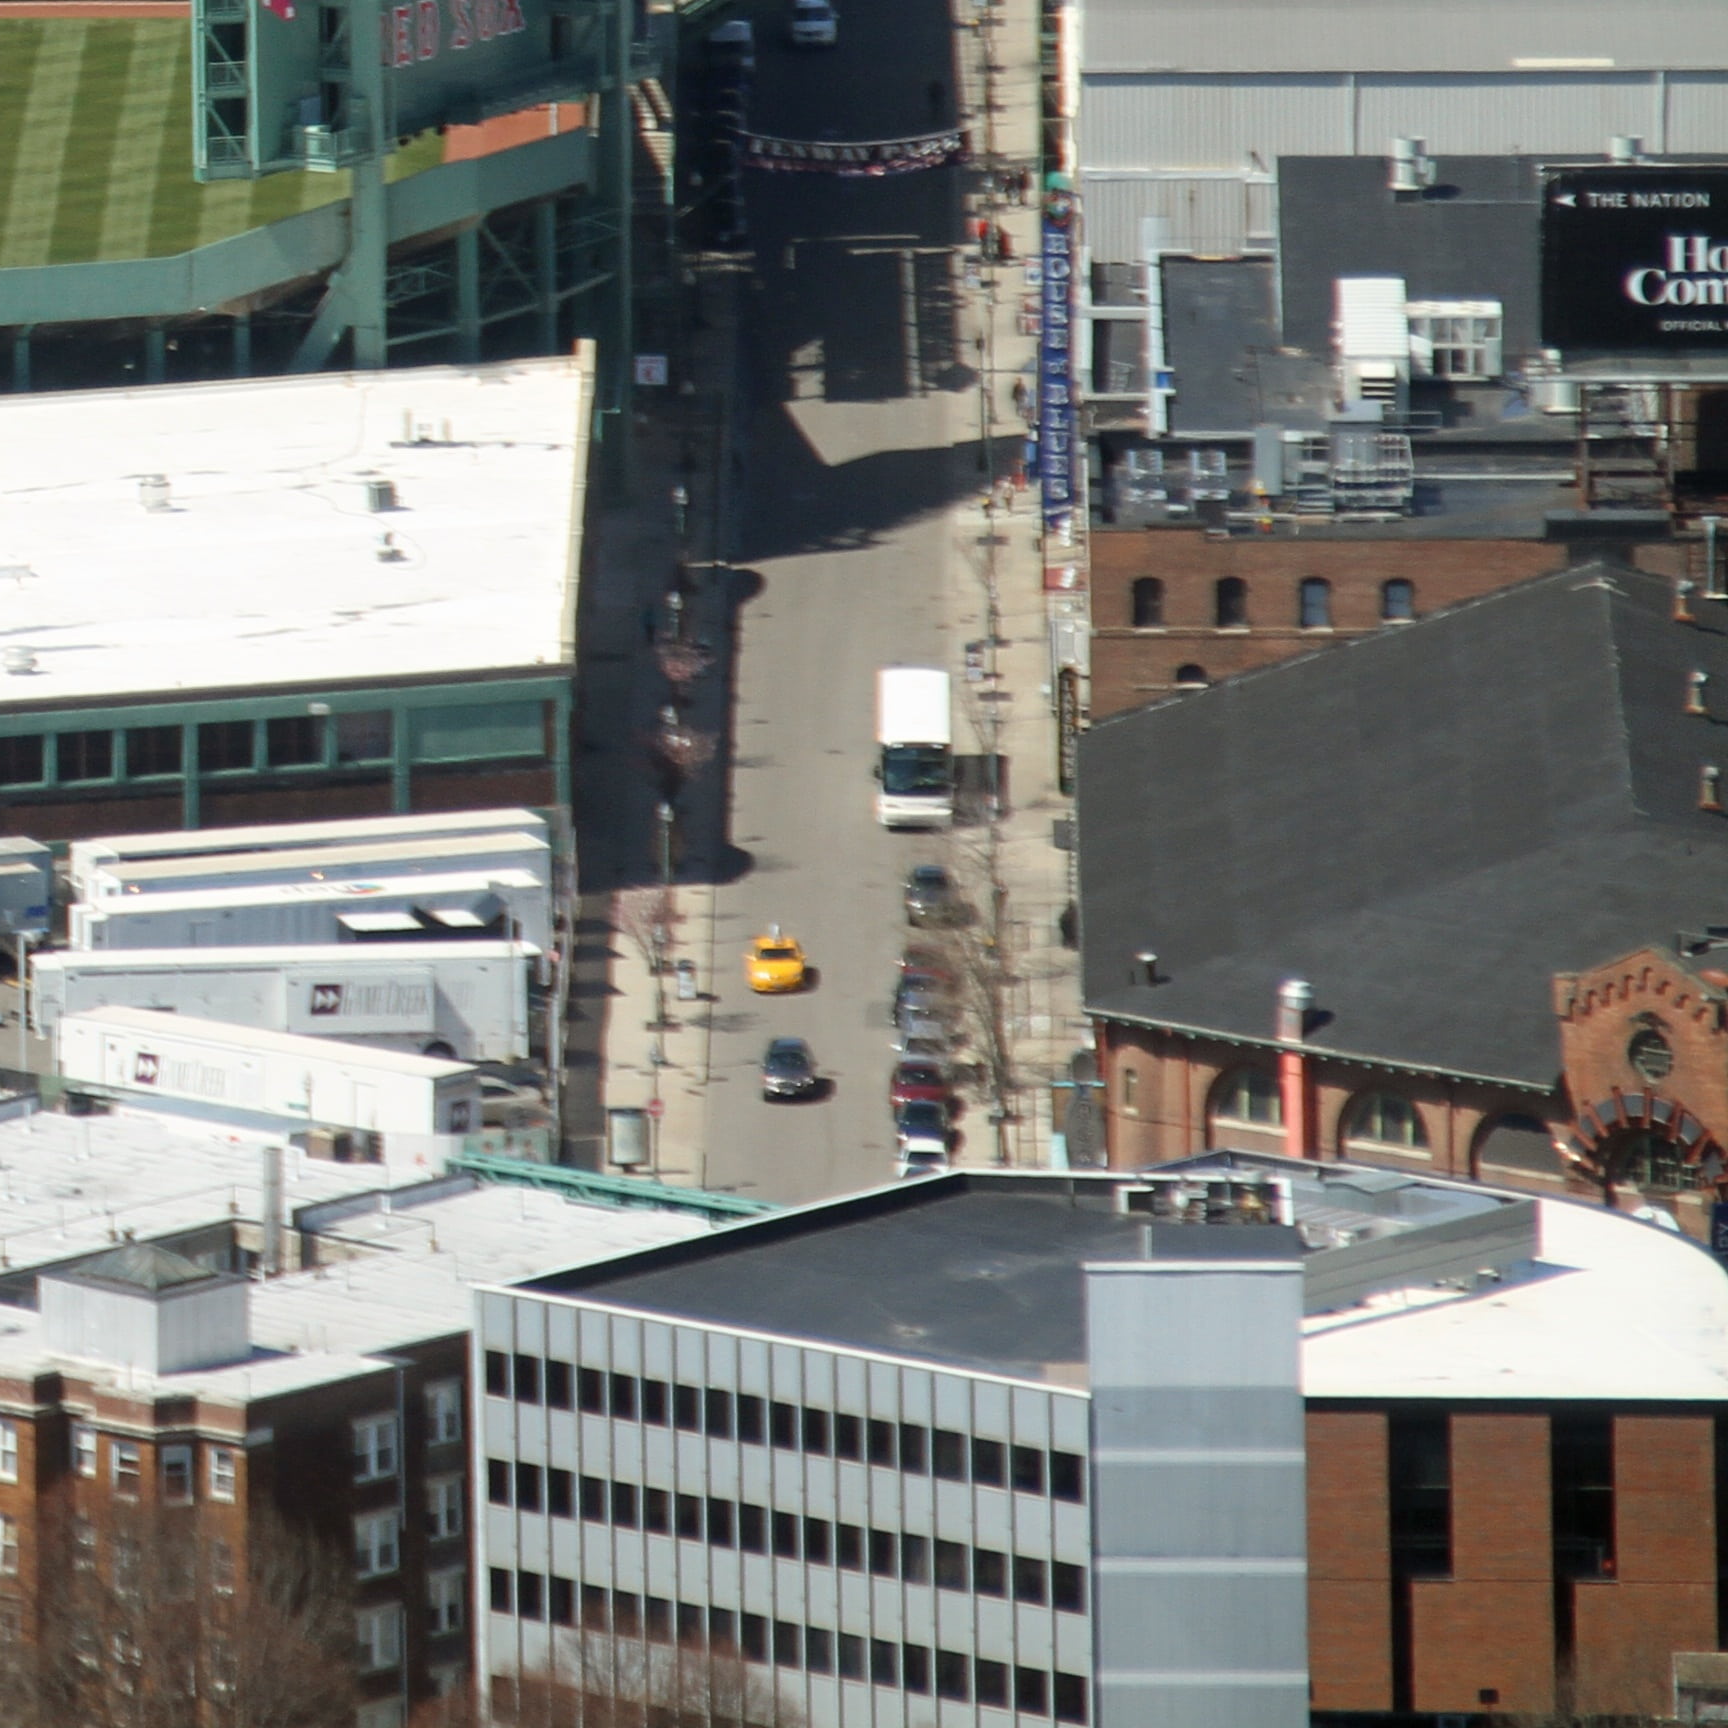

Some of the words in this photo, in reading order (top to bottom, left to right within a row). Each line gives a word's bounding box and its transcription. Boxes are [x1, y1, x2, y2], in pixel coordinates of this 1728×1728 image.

[1588, 192, 1629, 208] THE
[1632, 192, 1711, 208] NATION
[1044, 233, 1071, 349] HOUSE
[1661, 321, 1722, 332] OFFICIAL
[1044, 384, 1070, 500] BLUES
